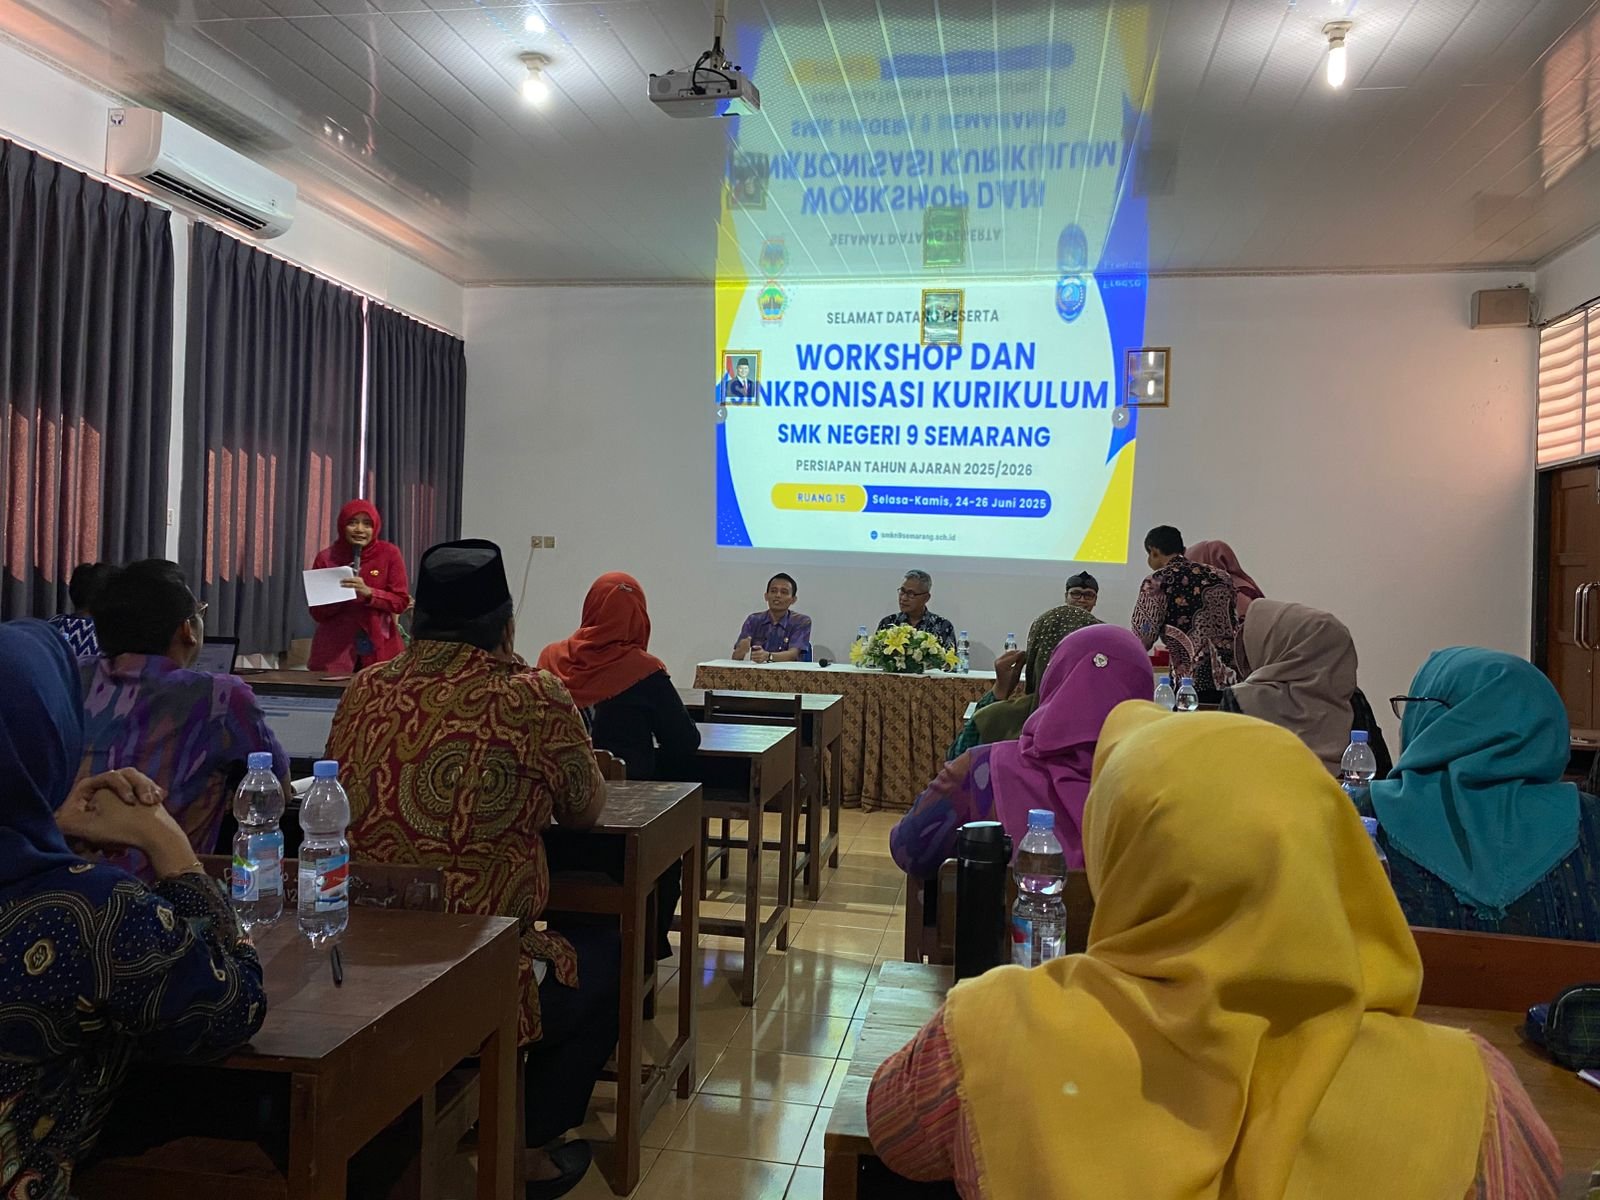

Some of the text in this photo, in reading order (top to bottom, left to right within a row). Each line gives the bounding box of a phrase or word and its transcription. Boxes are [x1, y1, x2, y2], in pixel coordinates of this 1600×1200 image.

[827, 310, 883, 324] SELAMAT
[943, 309, 999, 323] PESERTA
[796, 342, 1036, 371] WORKSHOP DAN
[933, 380, 1109, 409] KURIKULUM
[778, 423, 1051, 448] SMK NEGERI 9 SEMARANG
[796, 459, 1033, 478] PERSIAPAN TAHUN AJARAN 2025/2026
[797, 492, 846, 504] RUANG 15
[872, 494, 1047, 510] Selasa-Kamis, 24-26 Juni 2025
